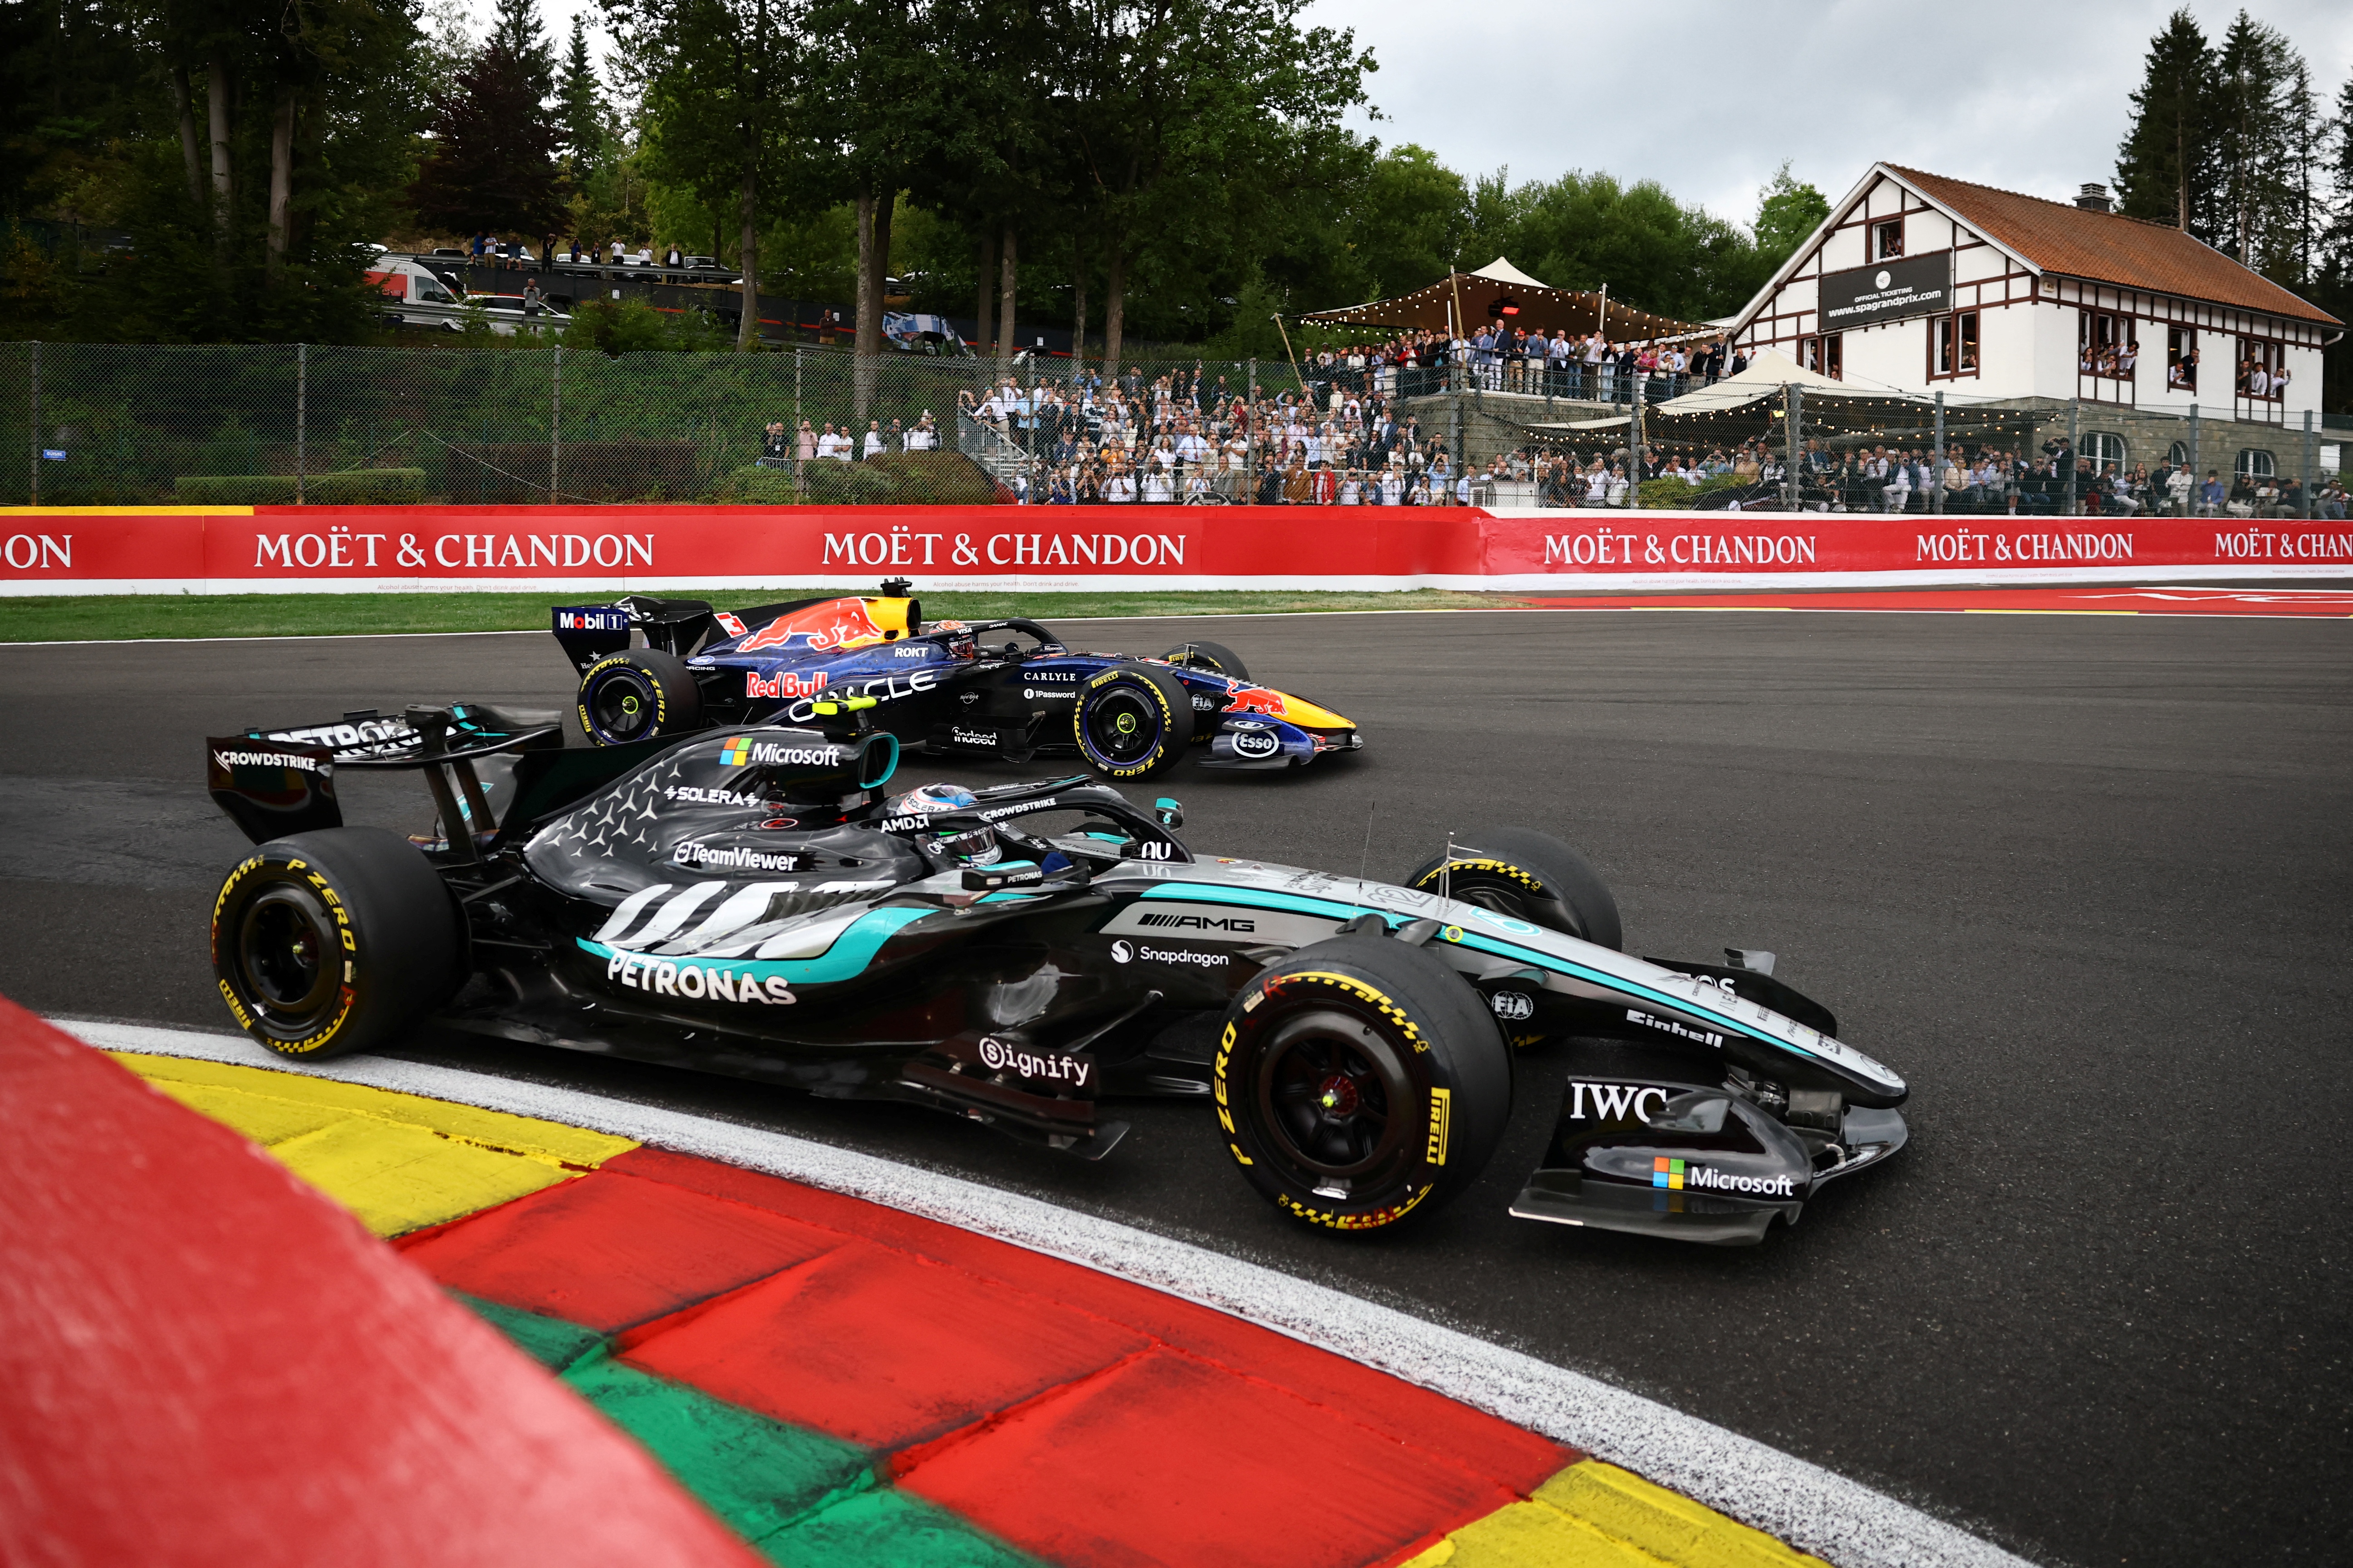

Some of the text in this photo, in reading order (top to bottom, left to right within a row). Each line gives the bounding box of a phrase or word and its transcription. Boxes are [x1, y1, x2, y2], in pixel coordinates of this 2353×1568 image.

[1828, 289, 1941, 317] www.spagrandprix.com
[1854, 286, 1913, 303] OFFICIAL TICKETING
[0, 534, 73, 568] ON
[254, 526, 655, 568] MOËT & CHANDON
[822, 525, 1186, 565] MOËT & CHANDON
[1544, 527, 1816, 564] MOËT & CHANDON
[1917, 528, 2132, 561] MOËT & CHANDON
[2215, 528, 2353, 558] MOËT & CHAN
[560, 612, 604, 629] Mobil
[894, 647, 928, 657] ROKT
[746, 671, 828, 698] Red Bull
[1024, 672, 1076, 681] CARLYLE
[1091, 671, 1119, 688] PIRELLI
[650, 679, 666, 723] ZERO
[952, 727, 997, 745] indeed
[1239, 734, 1272, 749] Esso
[221, 751, 316, 771] CROWDSTRIKE
[751, 742, 840, 766] Microsoft
[1113, 745, 1164, 776] P ZERO
[676, 786, 745, 806] SOLERA
[983, 797, 1057, 819] CROWDSTRIKE
[880, 817, 916, 833] AMD
[692, 843, 798, 872] TeamViewer
[1007, 870, 1043, 883] PETRONAS
[287, 858, 307, 870] P
[307, 871, 356, 951] ZERO
[1173, 916, 1255, 932] AMG
[1140, 946, 1229, 967] Snapdragon
[608, 950, 797, 1005] PETRONAS
[219, 979, 253, 1030] PIRELLI
[1626, 1009, 1723, 1049] Einhell
[1214, 1021, 1254, 1166] ZERO P
[1570, 1082, 1667, 1124] IWC
[1426, 1086, 1451, 1166] PIRELLI
[1690, 1166, 1794, 1197] Microsoft
